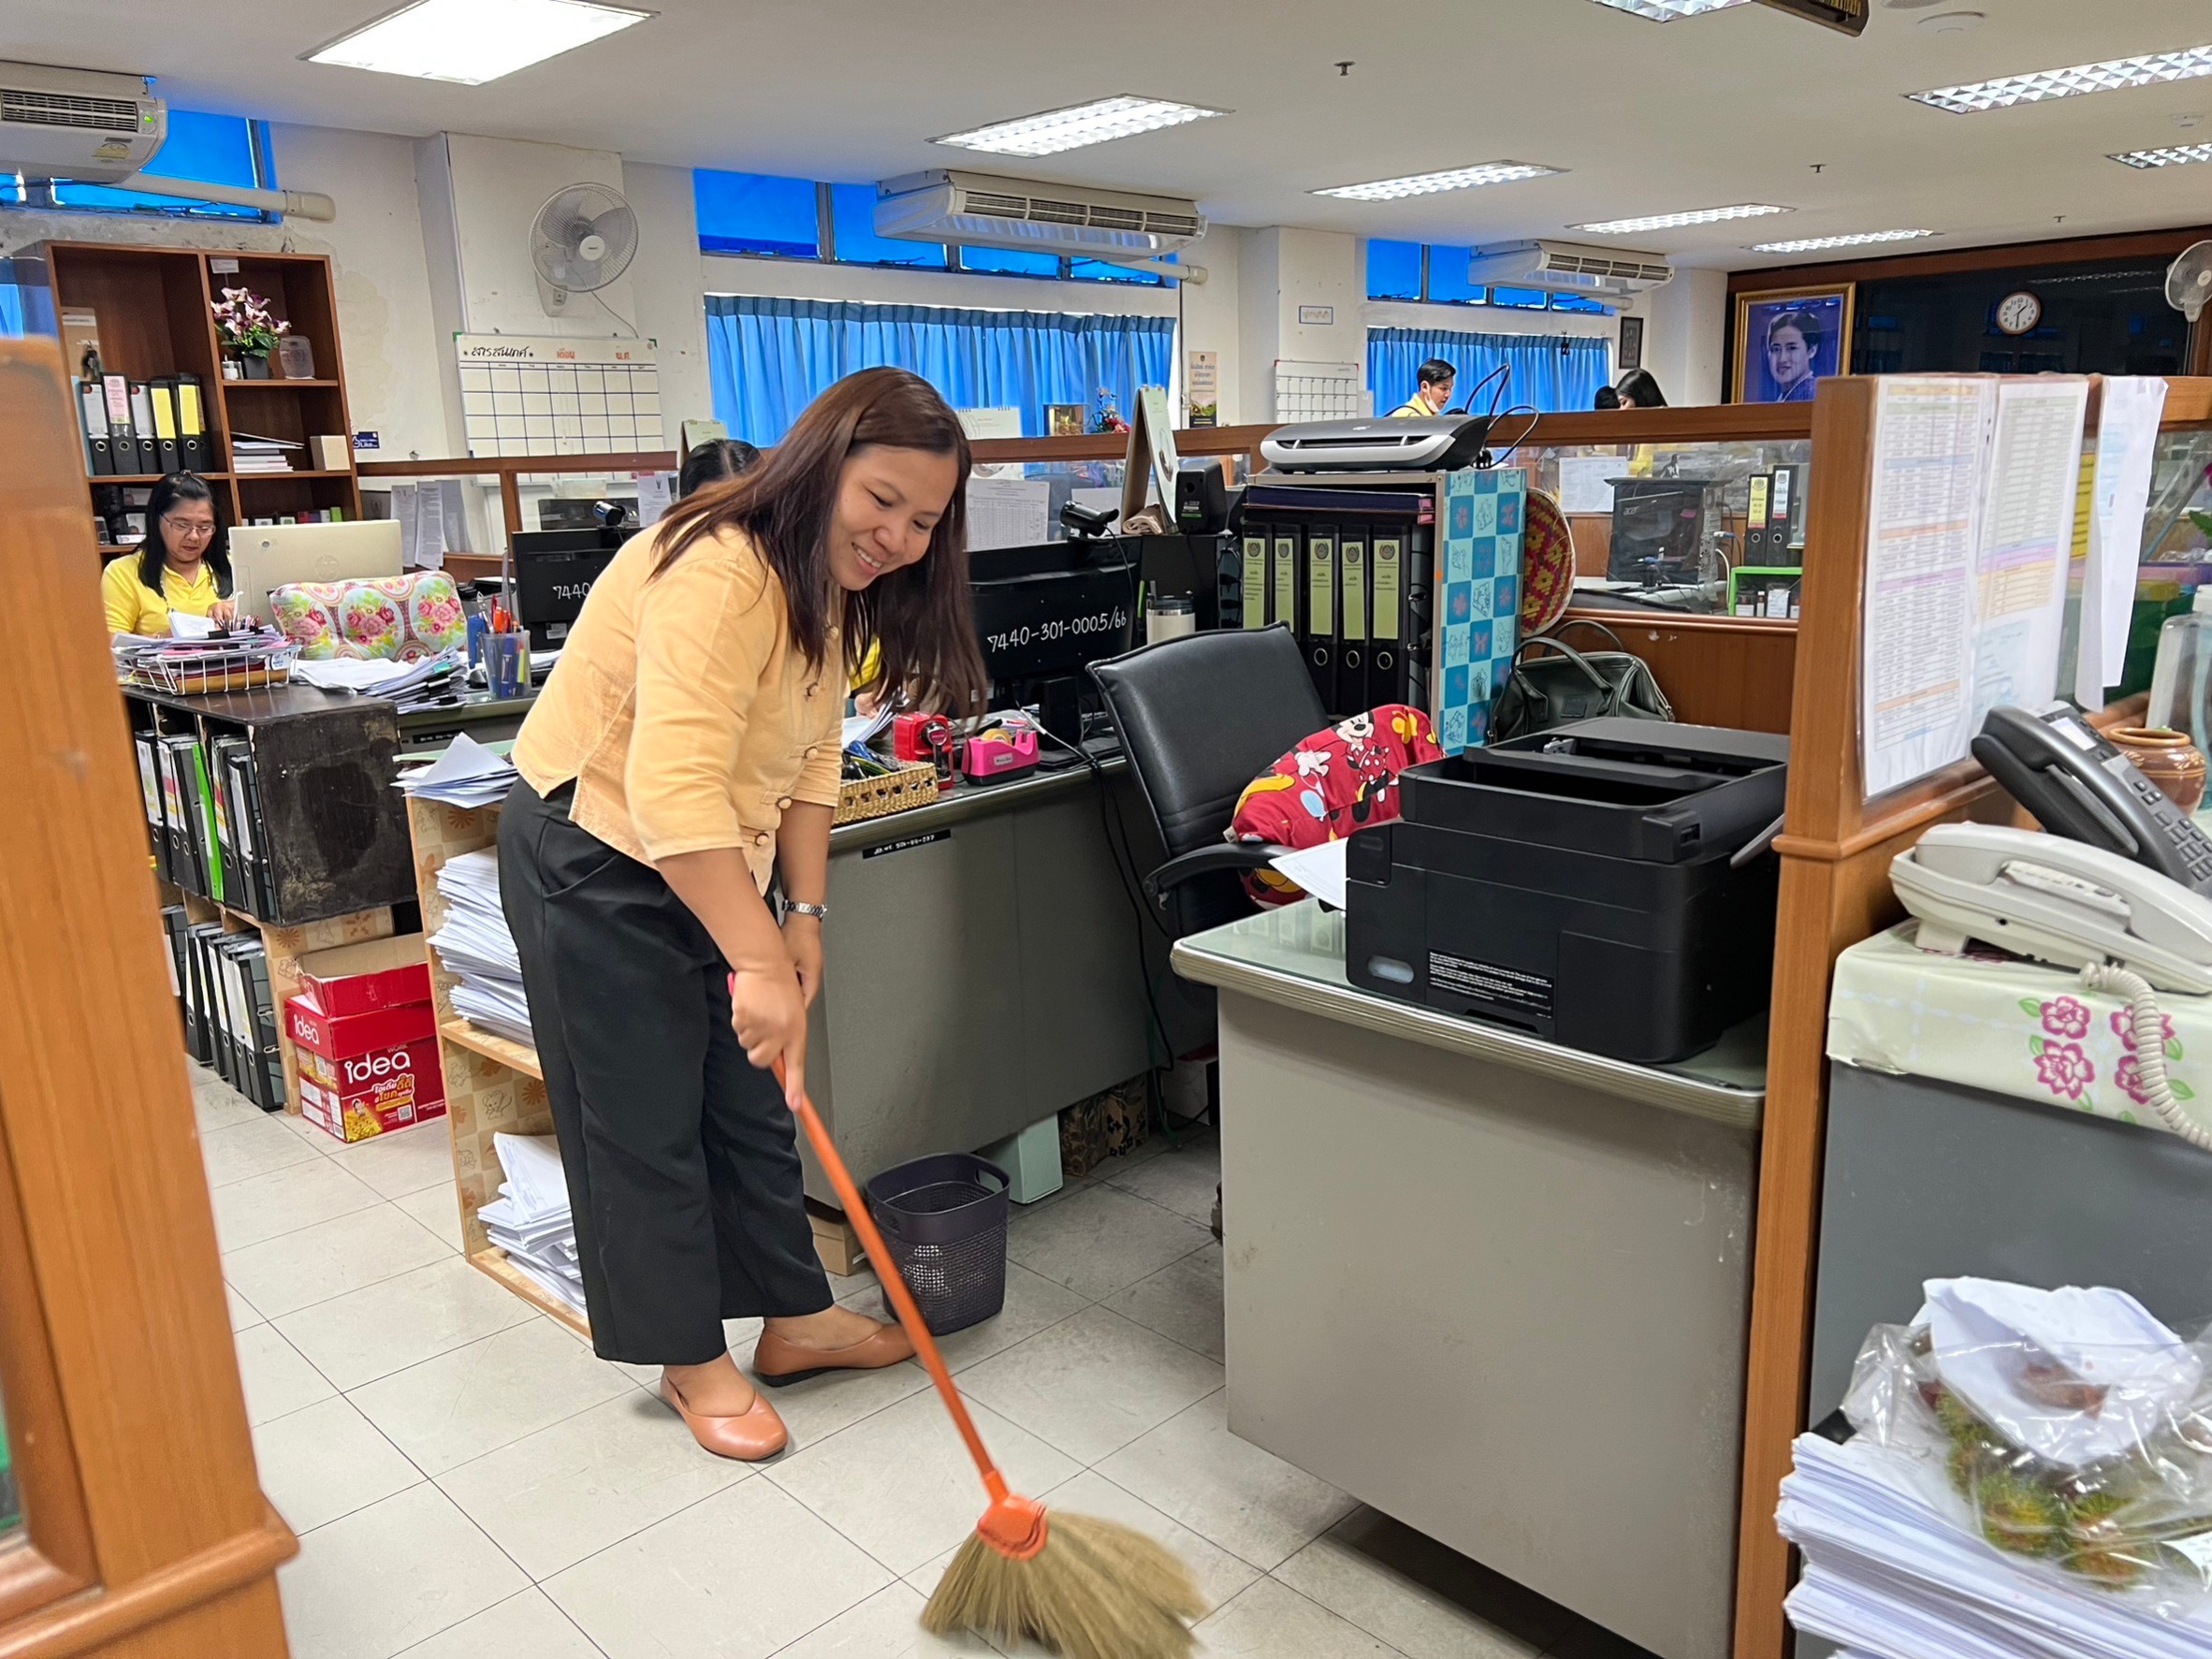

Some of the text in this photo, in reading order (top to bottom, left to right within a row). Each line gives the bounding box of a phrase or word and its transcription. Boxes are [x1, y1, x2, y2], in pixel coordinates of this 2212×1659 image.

[557, 348, 575, 359] เดือน
[552, 582, 591, 600] 7440
[986, 605, 1127, 653] 7440-301-0005/66
[293, 1013, 320, 1046] idea
[343, 1051, 412, 1084] idea
